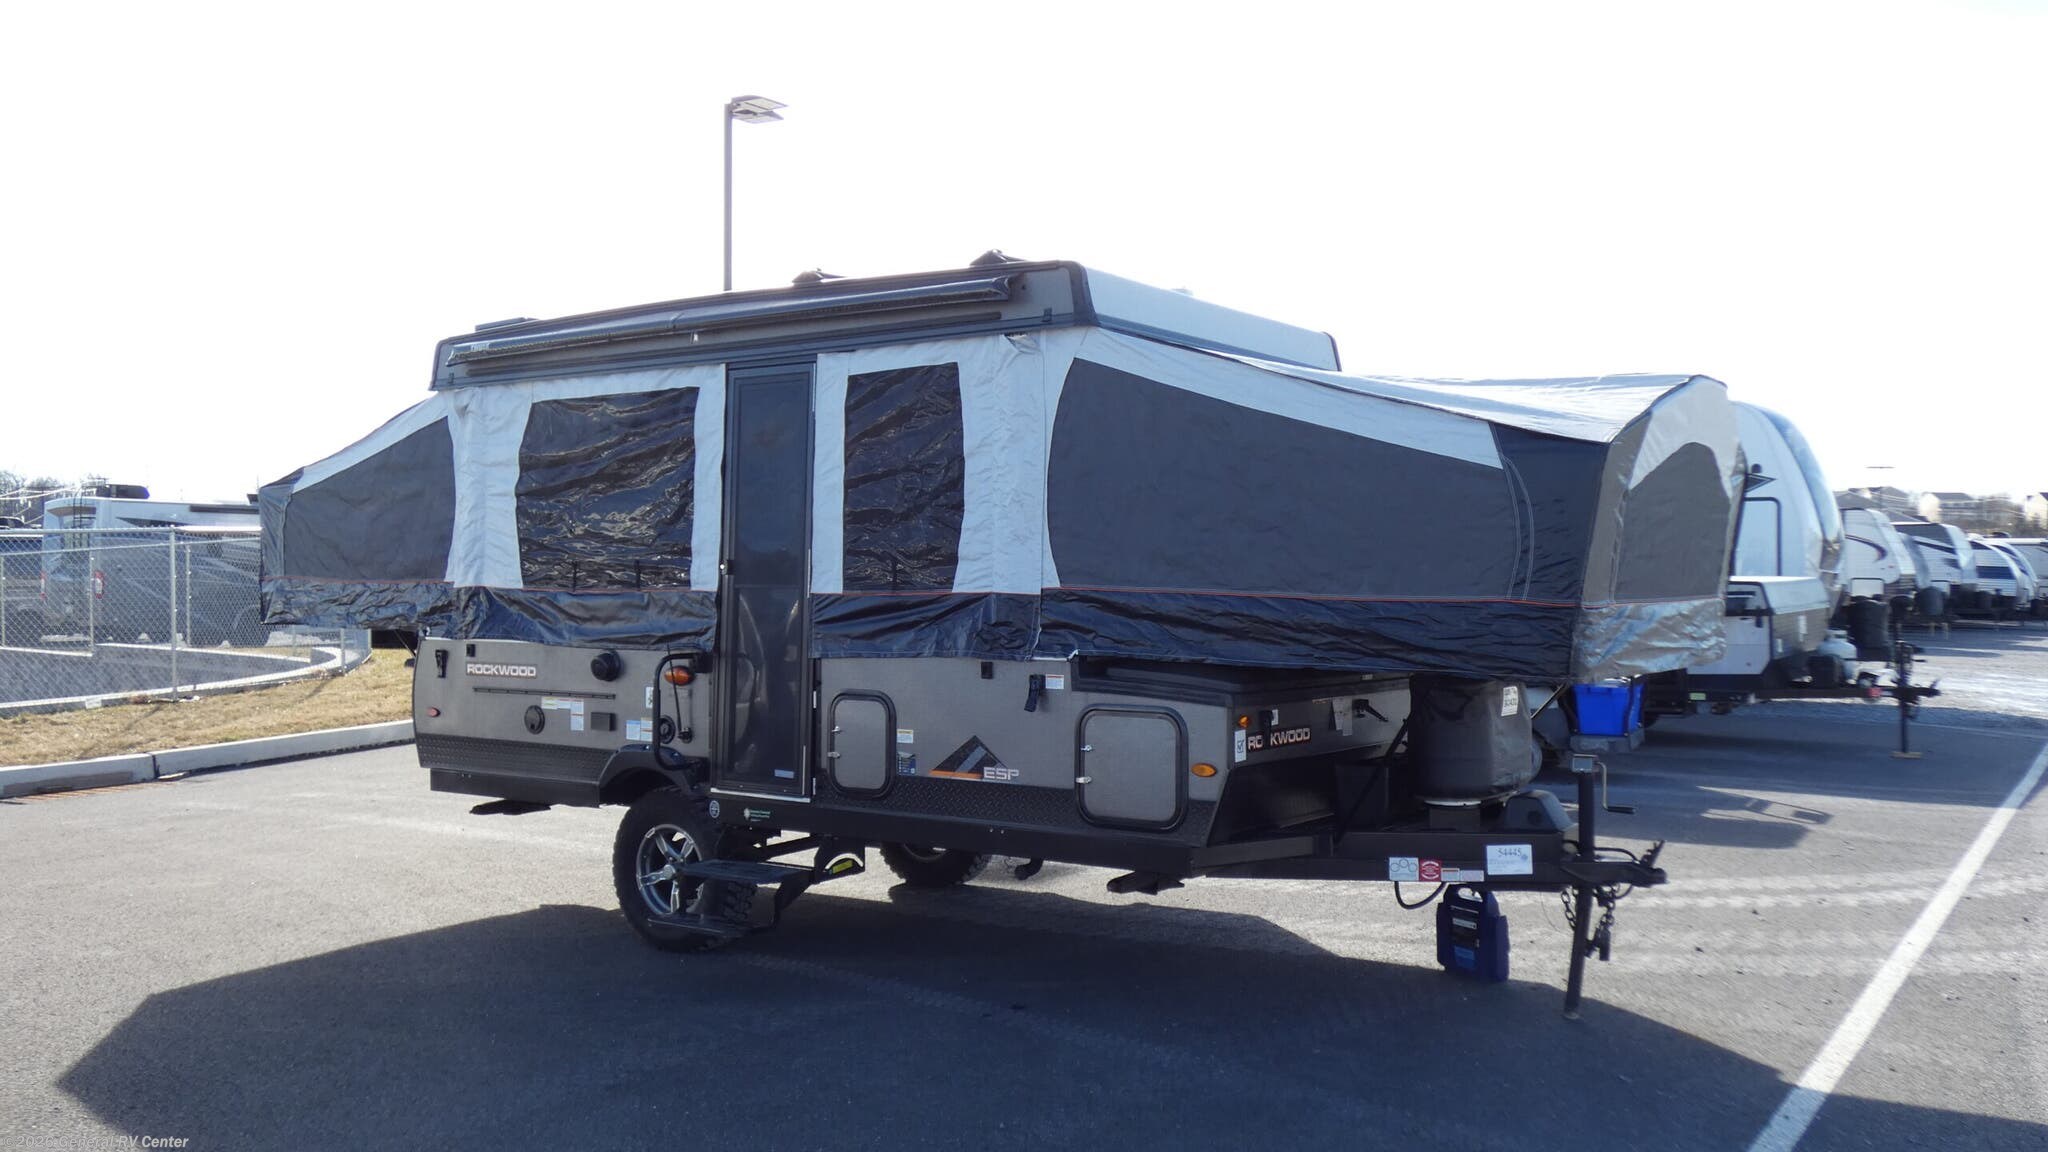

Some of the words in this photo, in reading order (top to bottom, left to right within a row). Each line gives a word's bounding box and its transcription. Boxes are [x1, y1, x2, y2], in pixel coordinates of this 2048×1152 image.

[466, 663, 537, 677] ROCKWOOD
[1247, 727, 1311, 750] ROKWOOD
[983, 766, 1019, 781] ESP
